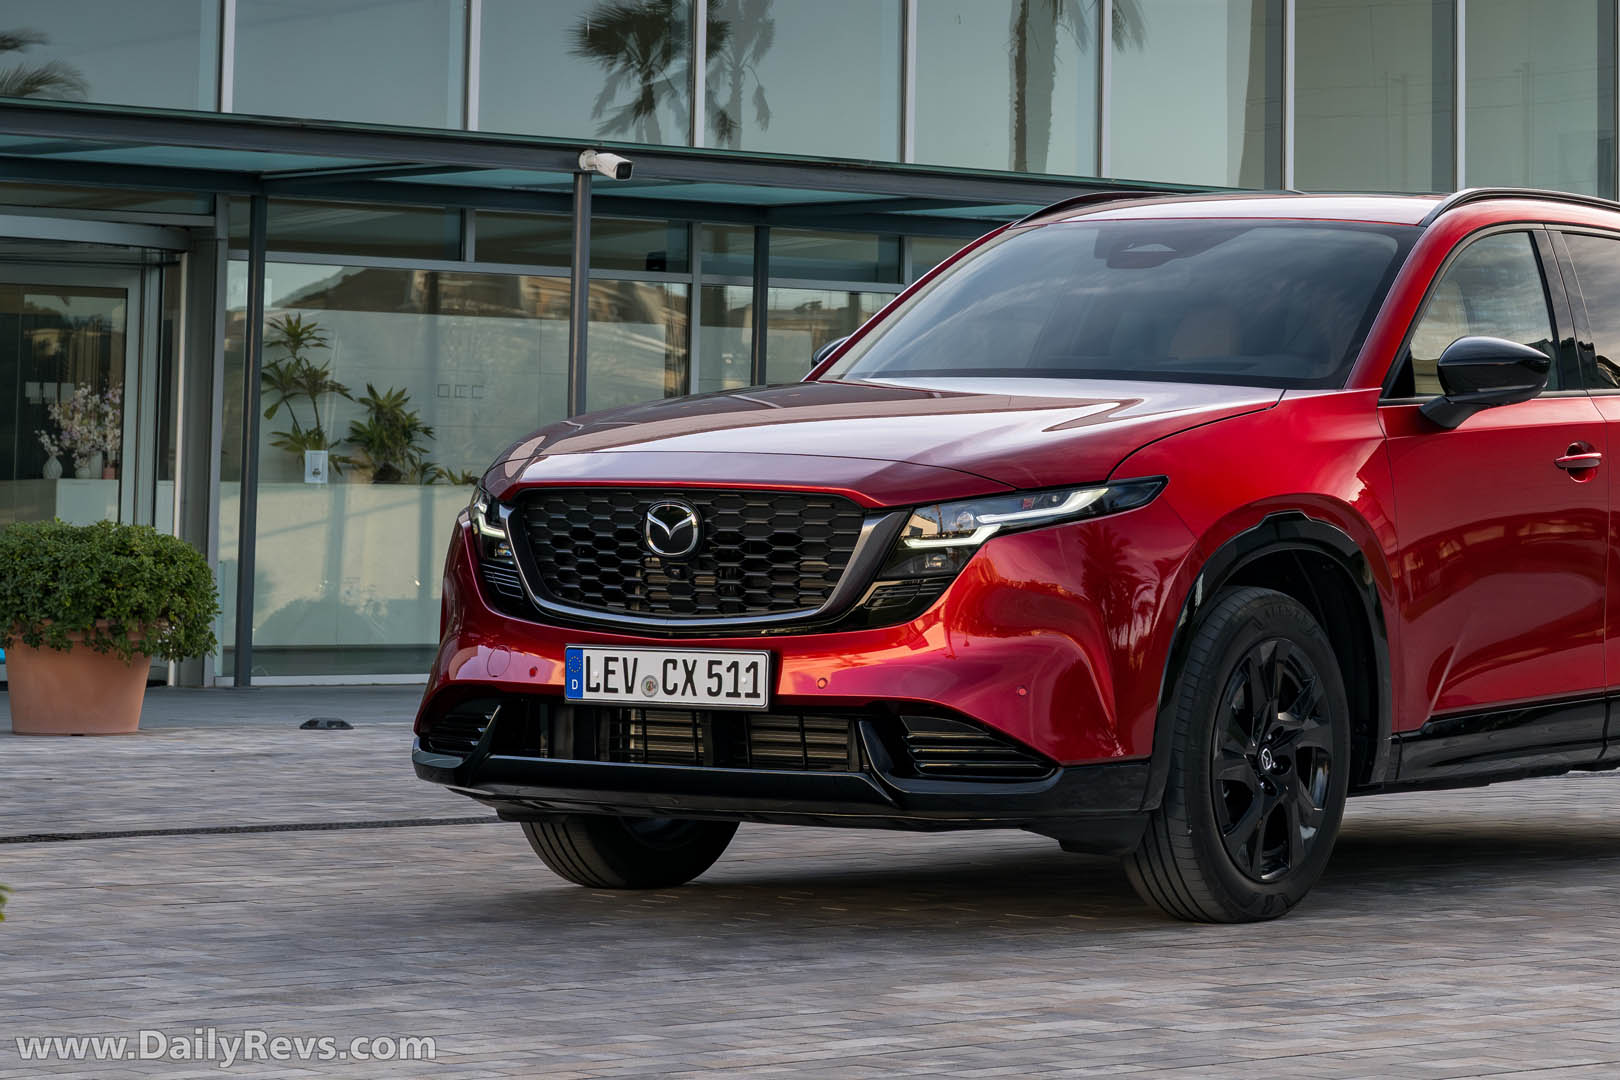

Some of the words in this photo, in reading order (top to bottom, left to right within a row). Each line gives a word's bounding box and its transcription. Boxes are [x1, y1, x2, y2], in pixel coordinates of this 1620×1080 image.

[571, 678, 579, 690] D
[585, 655, 639, 695] LEV
[661, 658, 698, 697] CX
[707, 659, 761, 699] 511
